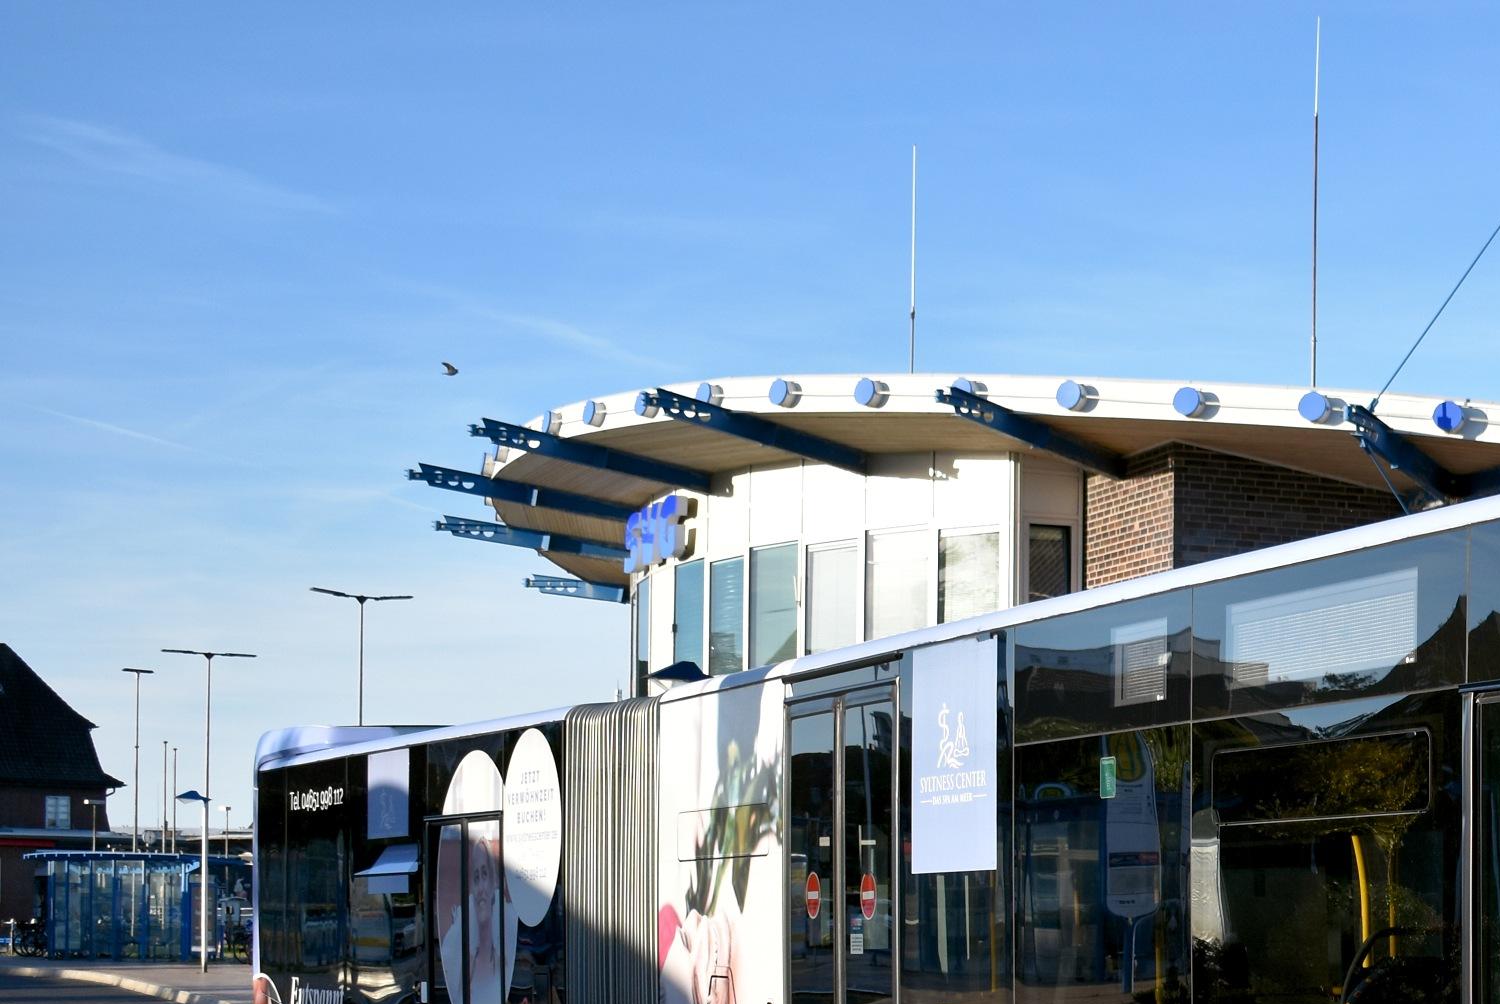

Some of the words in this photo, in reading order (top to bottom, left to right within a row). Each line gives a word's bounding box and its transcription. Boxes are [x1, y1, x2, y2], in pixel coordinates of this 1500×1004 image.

[520, 769, 541, 785] JETZT
[920, 775, 954, 793] SYLTNESS
[956, 771, 987, 789] CENTER
[320, 786, 333, 811] 998
[333, 787, 344, 805] 112
